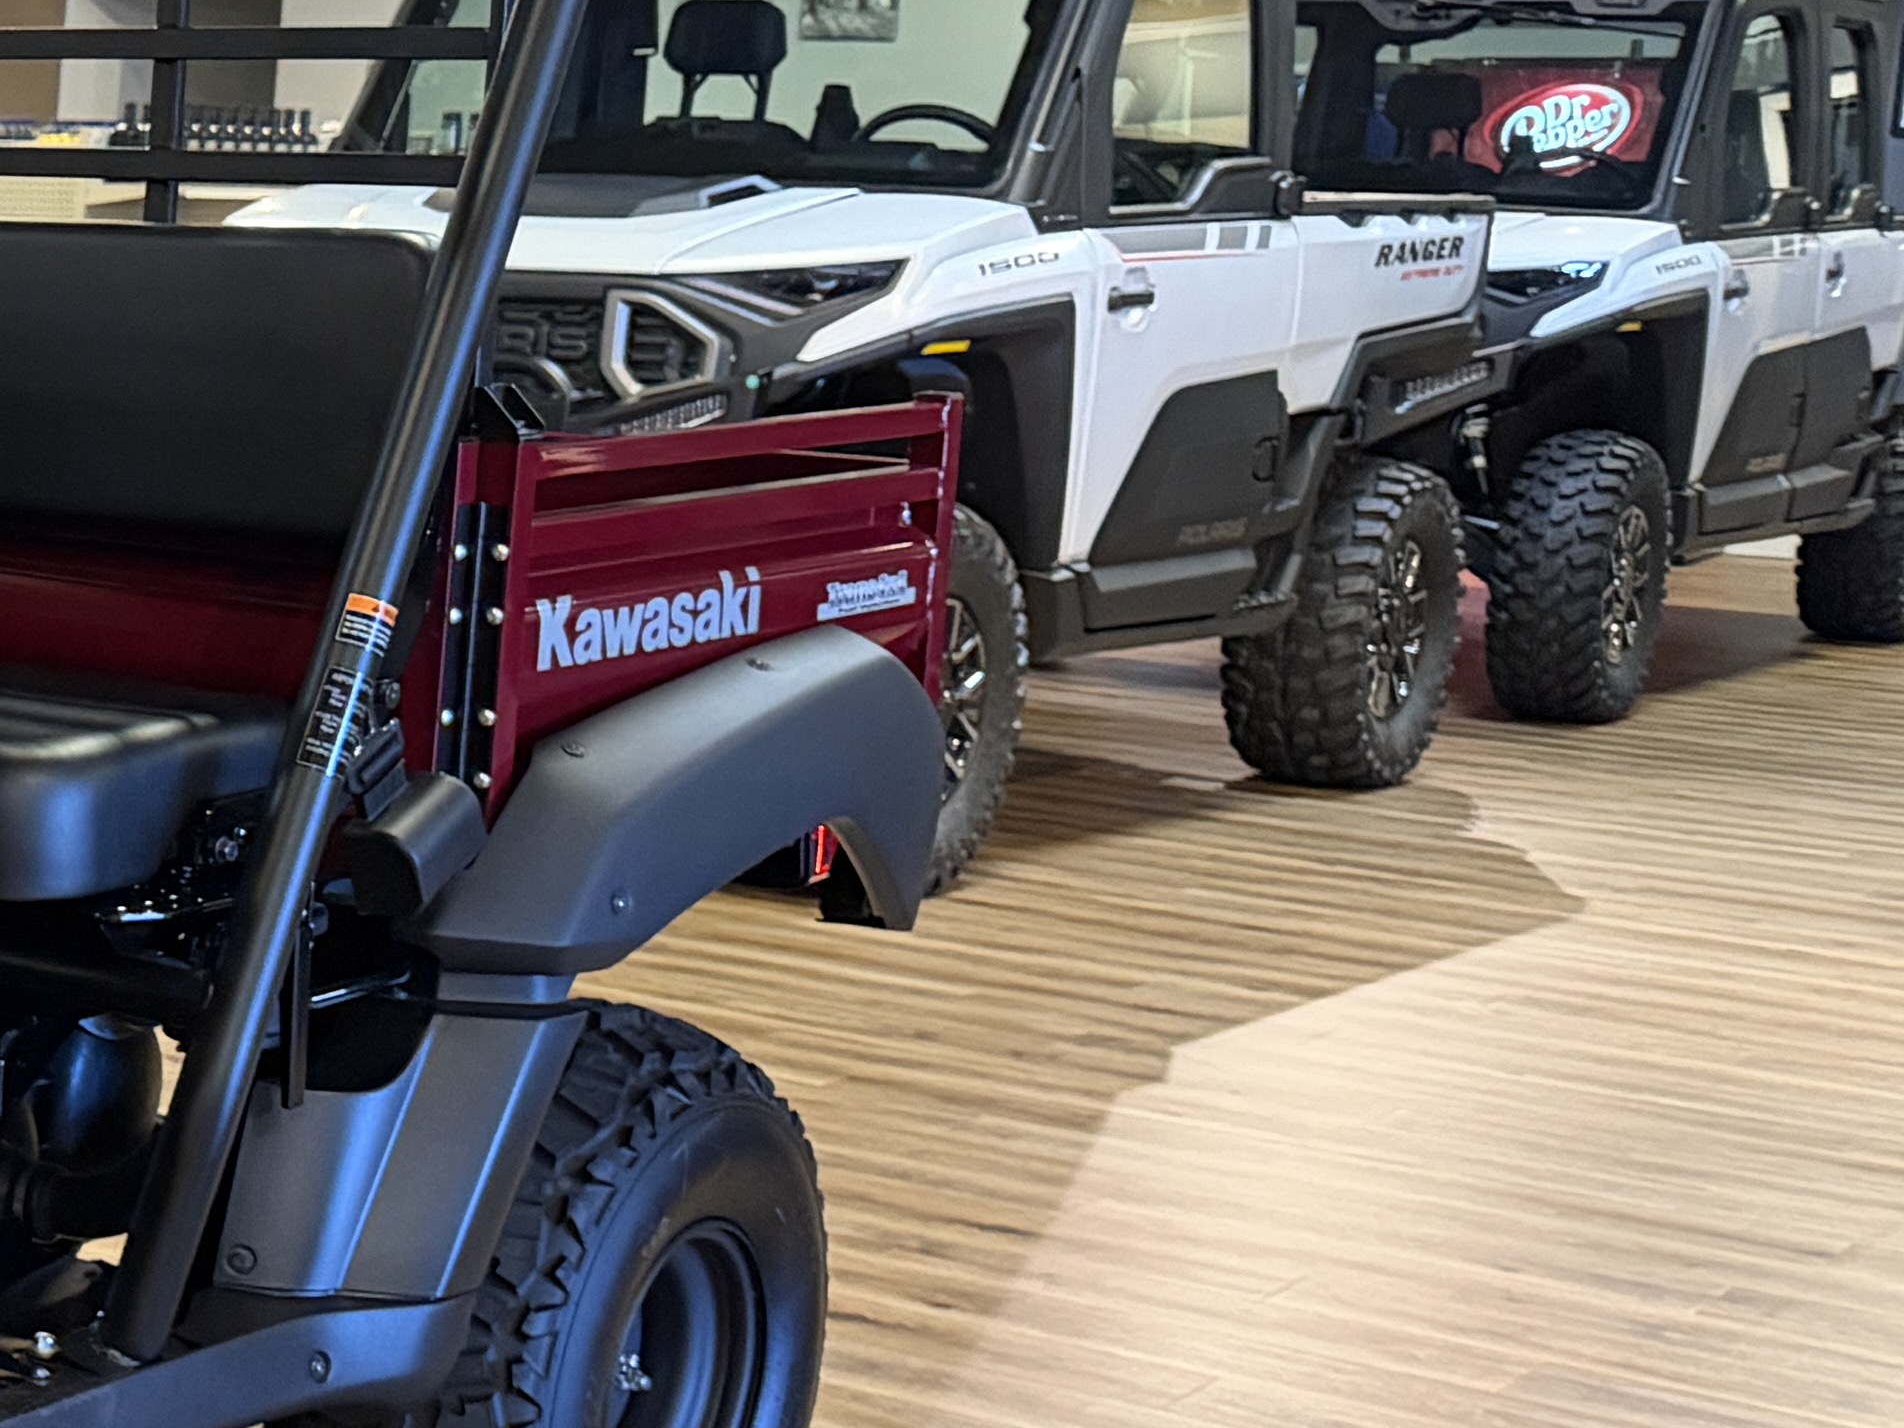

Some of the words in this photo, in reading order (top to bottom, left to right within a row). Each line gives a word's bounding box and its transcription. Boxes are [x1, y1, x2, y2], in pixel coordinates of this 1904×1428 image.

[978, 252, 1060, 276] 1500
[1375, 236, 1464, 268] RANGER
[1655, 254, 1702, 275] 1500
[535, 565, 761, 671] Kawasaki
